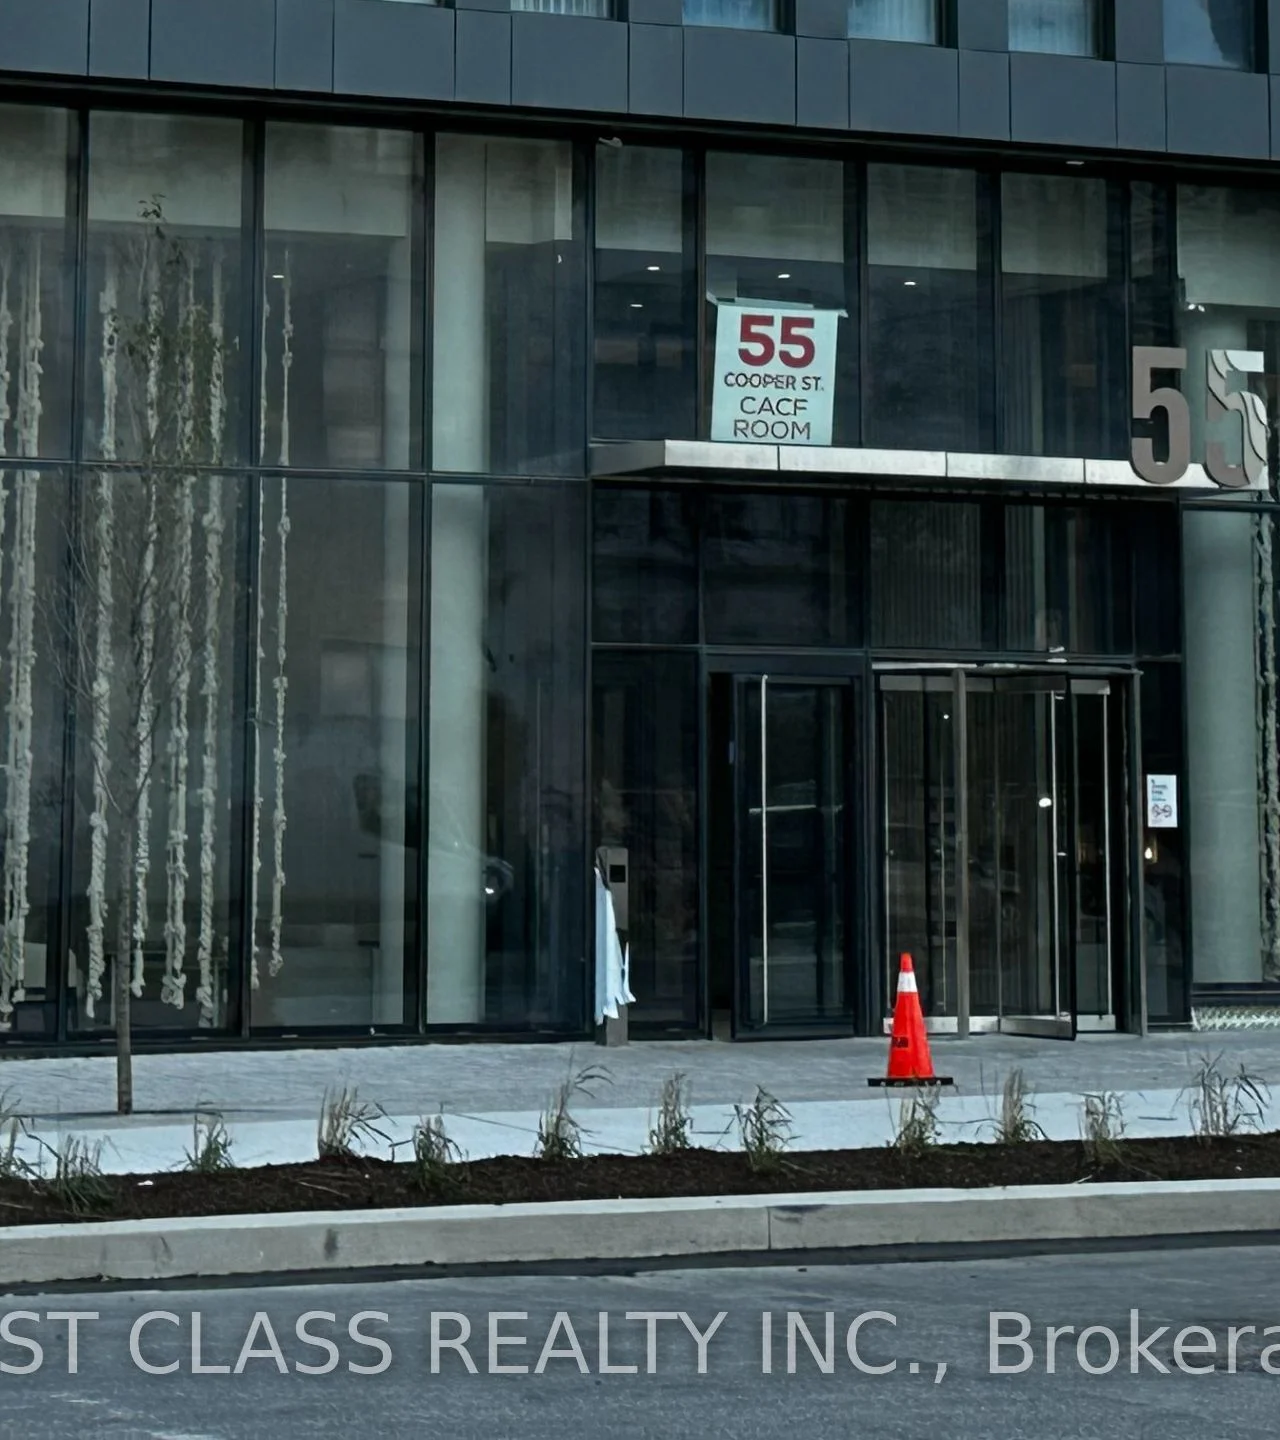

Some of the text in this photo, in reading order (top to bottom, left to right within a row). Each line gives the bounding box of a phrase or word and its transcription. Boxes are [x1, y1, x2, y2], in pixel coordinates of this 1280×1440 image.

[738, 313, 815, 368] 55
[724, 372, 797, 391] COOPER
[733, 419, 811, 440] ROOM
[1131, 345, 1268, 488] 55
